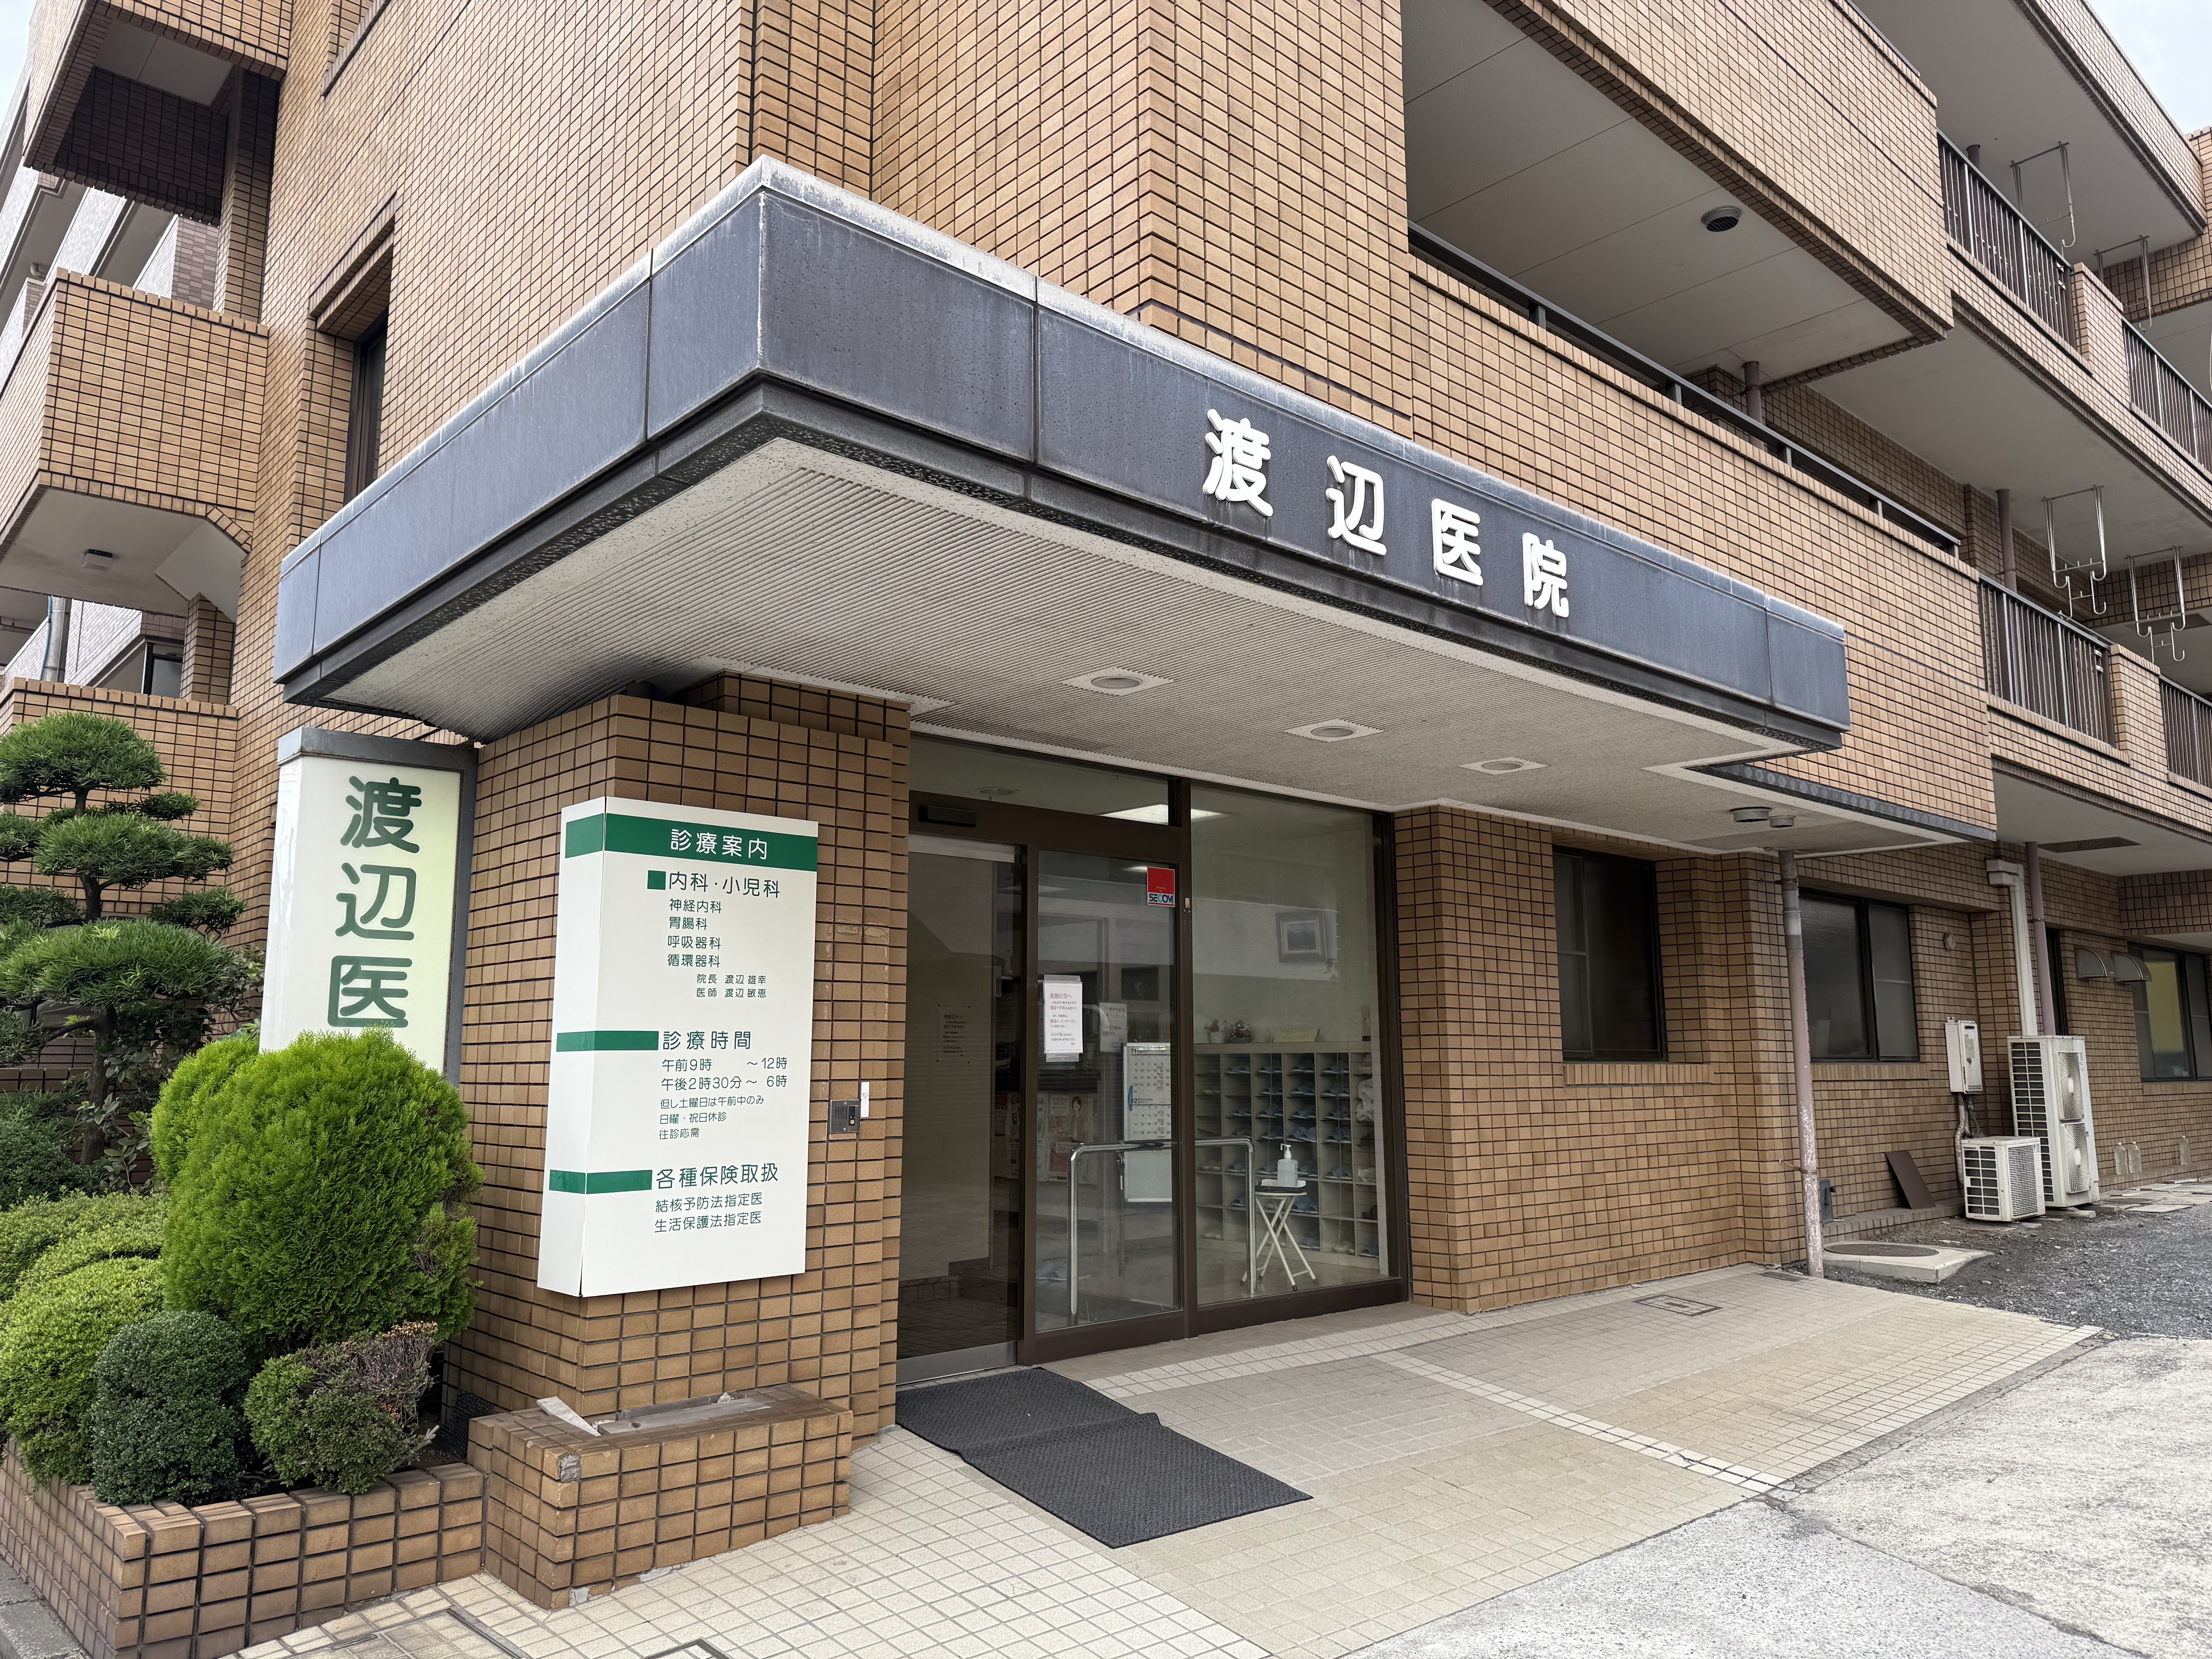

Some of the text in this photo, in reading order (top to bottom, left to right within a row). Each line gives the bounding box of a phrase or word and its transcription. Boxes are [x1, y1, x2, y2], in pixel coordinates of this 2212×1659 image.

[1202, 408, 1569, 618] 渡辺医院
[670, 829, 767, 860] 診療案内
[1149, 893, 1173, 903] SECOM
[669, 898, 722, 914] 神経内科
[670, 917, 707, 930] 胃腸科
[668, 936, 721, 950] 呼吸器科
[668, 954, 720, 968] 循環器科
[697, 974, 717, 984] 院長
[697, 988, 716, 997] 医師
[663, 1030, 750, 1050] 診療時間
[662, 1058, 712, 1072] 午前9時
[661, 1096, 764, 1109] 但し土曜日は午前中のみ
[659, 1128, 699, 1139] 往診応需
[656, 1163, 778, 1189] 各種保険取扱
[656, 1192, 762, 1213] 結核予防法指定医
[654, 1211, 761, 1233] 生活保護法指定医
